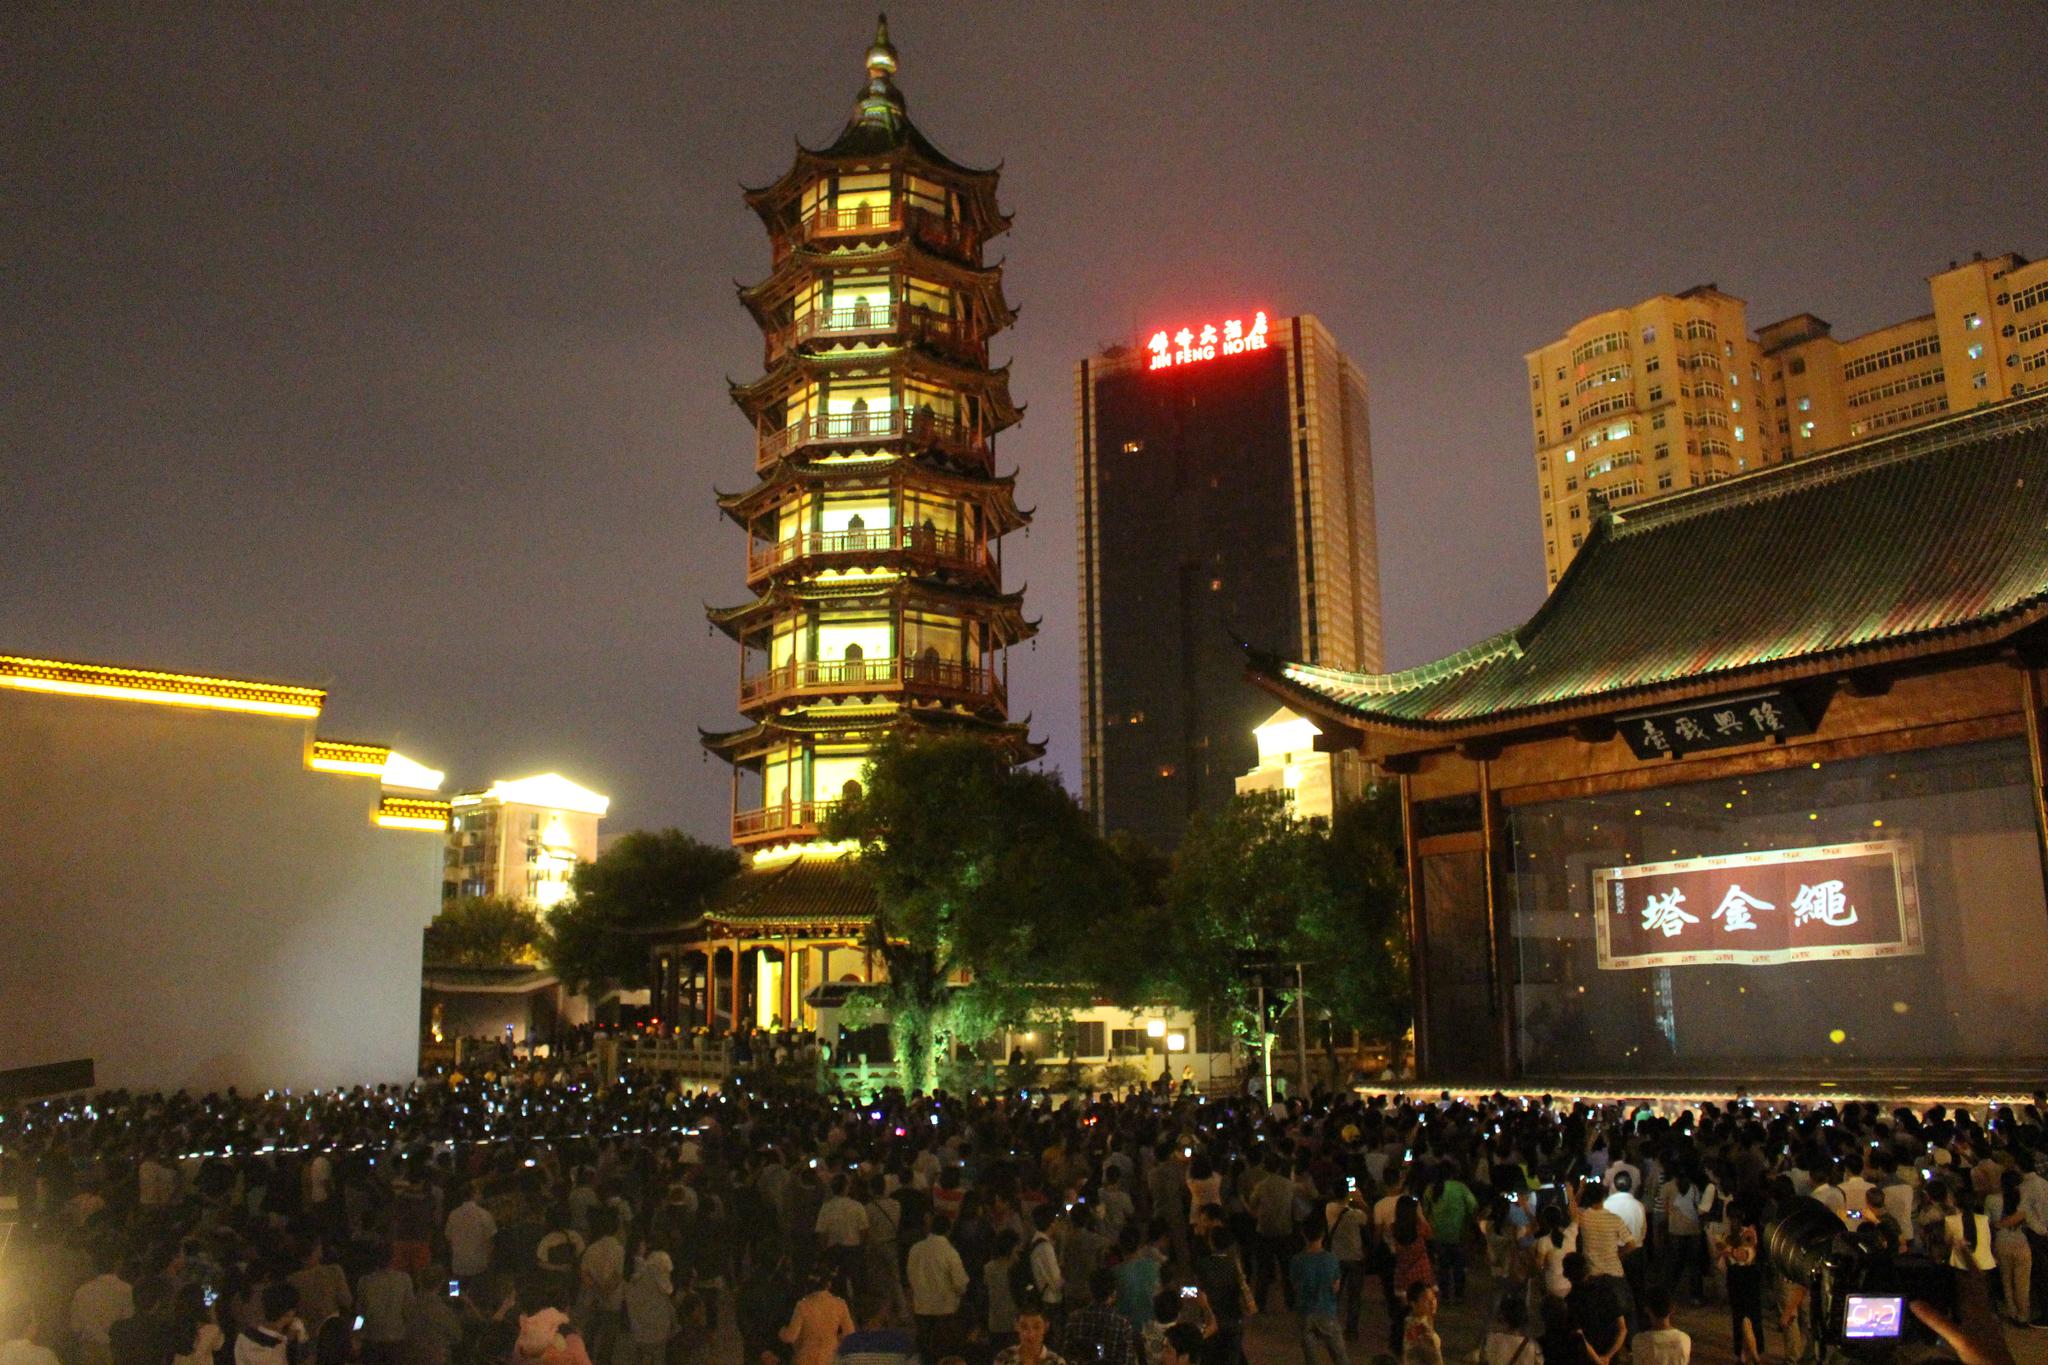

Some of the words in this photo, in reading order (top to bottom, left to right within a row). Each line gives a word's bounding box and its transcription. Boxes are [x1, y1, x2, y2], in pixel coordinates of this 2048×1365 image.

[1150, 353, 1172, 370] JIN
[1176, 345, 1215, 364] FENG
[1223, 334, 1267, 355] HOTEL
